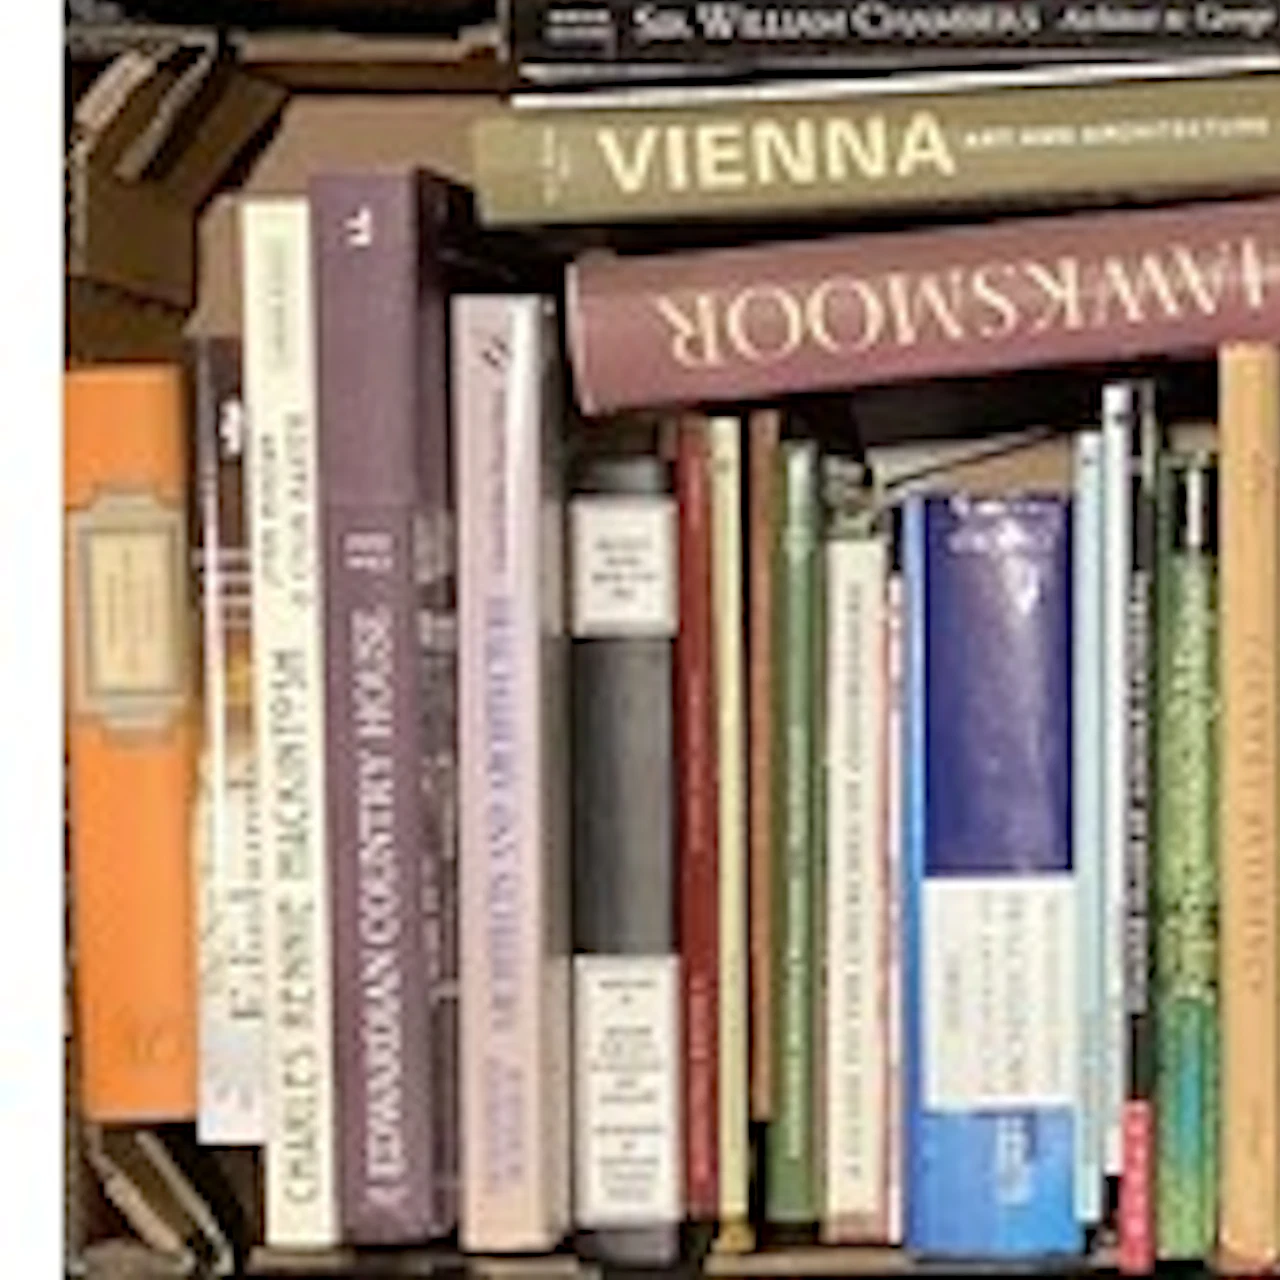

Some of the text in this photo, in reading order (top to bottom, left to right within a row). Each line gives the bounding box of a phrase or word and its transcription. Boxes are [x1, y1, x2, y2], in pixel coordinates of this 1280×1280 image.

[596, 111, 955, 192] VIENNA
[698, 2, 846, 39] WILLIAM
[850, 2, 1041, 36] CHAMBERS
[270, 646, 322, 1206] CHARLES RENNIE MACKINTOSH
[350, 605, 411, 1175] EDWARDIAN COUNTRY HOUSE
